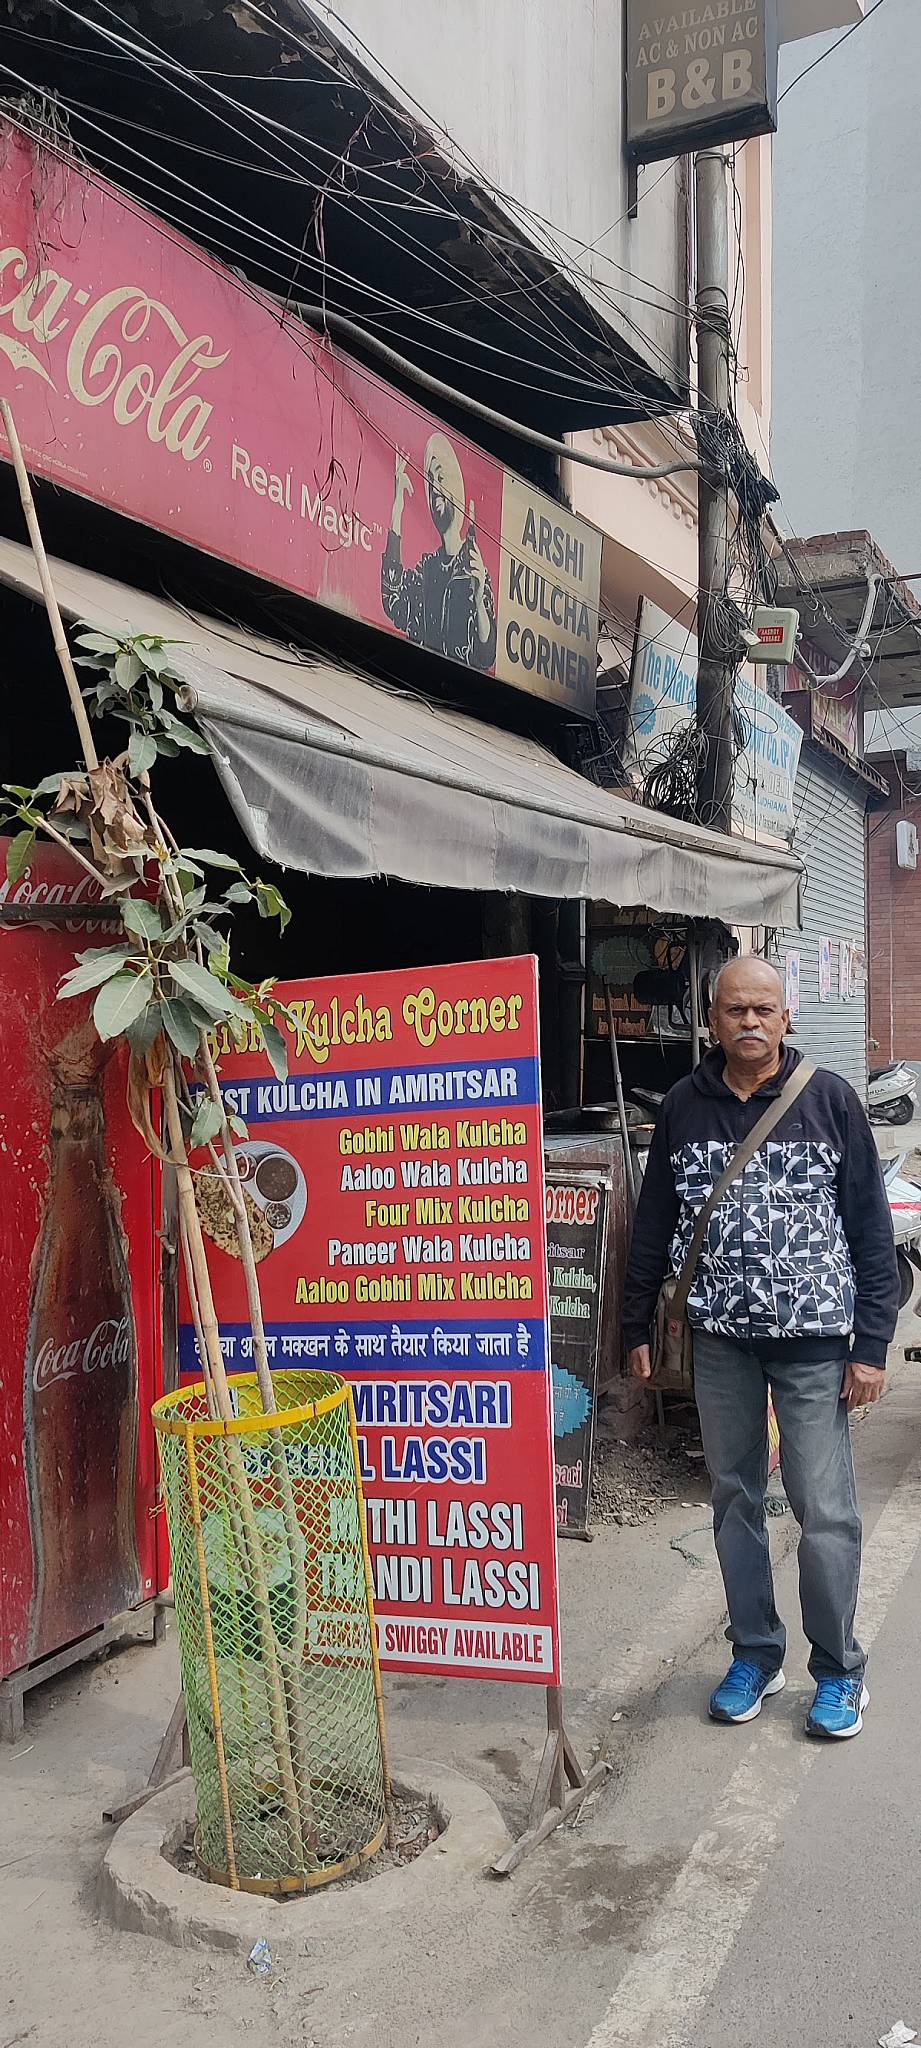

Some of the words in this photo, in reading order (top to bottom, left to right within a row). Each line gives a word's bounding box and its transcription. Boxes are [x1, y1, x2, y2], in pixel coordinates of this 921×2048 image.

[635, 43, 661, 68] AC
[665, 39, 679, 58] &
[684, 25, 726, 55] NON
[731, 16, 759, 42] AC
[638, 0, 757, 41] AVAILABLE
[647, 48, 753, 120] B&B
[231, 444, 293, 511] Real
[521, 507, 585, 583] ARSHI
[509, 558, 591, 642] KULCHA
[505, 620, 590, 692] CORNER
[641, 638, 662, 690] The
[286, 995, 394, 1064] Kulcha
[403, 986, 523, 1047] Corner
[257, 1079, 349, 1115] KULCHA
[355, 1077, 382, 1108] IN
[388, 1066, 519, 1103] AMRITSAR
[338, 1125, 395, 1156] Gobhi
[400, 1121, 450, 1152] Wala
[456, 1117, 528, 1149] Kulcha
[339, 1163, 396, 1193] Aaloo
[401, 1160, 451, 1190] Wala
[457, 1156, 528, 1186] Kulcha
[364, 1200, 410, 1228] Four
[415, 1198, 453, 1225] Mix
[458, 1194, 530, 1223] Kulcha
[328, 1239, 397, 1267] Paneer
[402, 1236, 453, 1264] Wala
[459, 1232, 531, 1262] Kulcha
[295, 1277, 349, 1305] Aaloo
[354, 1274, 412, 1302] Gobhi
[418, 1273, 455, 1301] Mix
[460, 1270, 533, 1301] Kulcha
[550, 1295, 591, 1319] Kulcha
[33, 1316, 129, 1392] Coca-Cola
[281, 1335, 331, 1359] मक्खन
[334, 1328, 350, 1358] के
[354, 1333, 387, 1358] साथ
[391, 1324, 429, 1358] तैयार
[432, 1326, 471, 1357] किया
[475, 1333, 512, 1357] जाता
[516, 1322, 531, 1358] है
[348, 1381, 512, 1428] MRITSARI
[381, 1436, 488, 1484] LASSI
[331, 1497, 417, 1546] MTHI
[427, 1500, 524, 1551] LASSI
[442, 1557, 541, 1611] LASSI
[385, 1623, 449, 1656] SWIGGY
[453, 1628, 544, 1664] AVAILABLE
